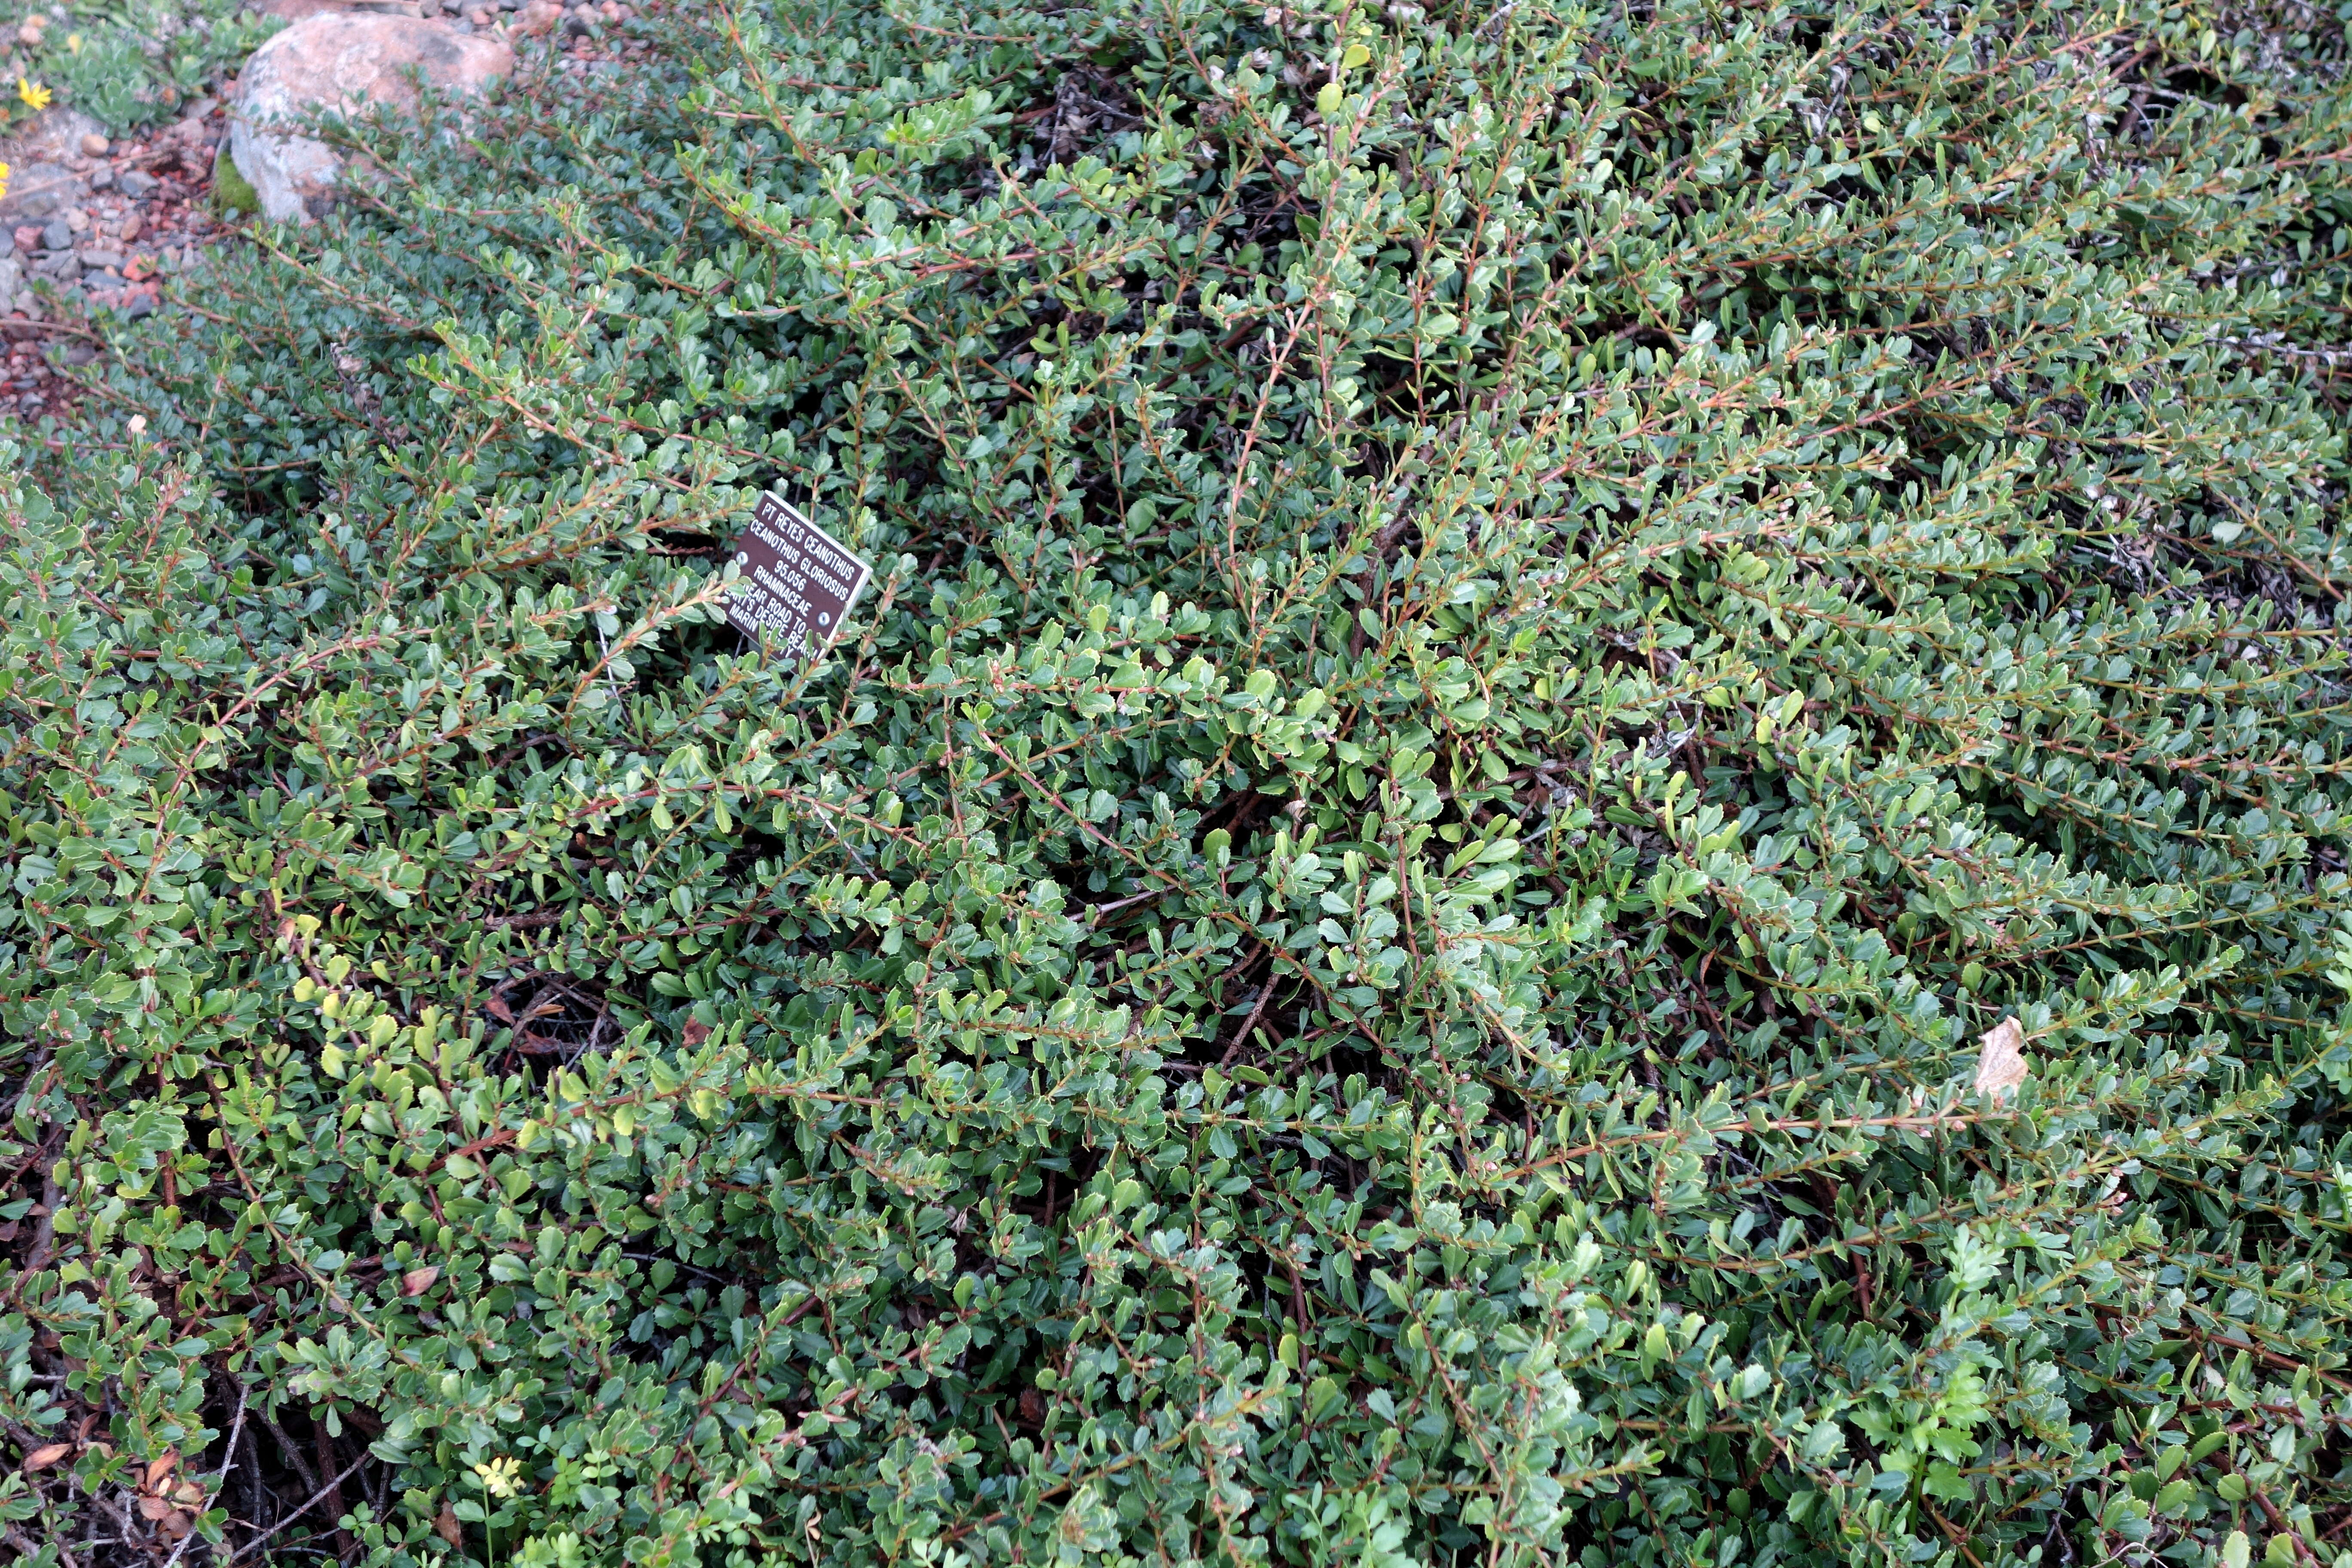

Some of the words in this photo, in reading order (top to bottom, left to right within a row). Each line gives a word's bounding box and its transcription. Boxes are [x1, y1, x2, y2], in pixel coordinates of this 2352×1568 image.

[750, 519, 800, 564] CEANOTHUS
[800, 558, 848, 600] GLORIOSUS
[762, 502, 777, 521] PT
[775, 513, 805, 542] REYES
[804, 535, 855, 581] CEANOTHUS
[754, 565, 812, 617] RHAMNACEAE
[774, 560, 807, 591] 95.056
[729, 603, 759, 632] MARIN
[767, 597, 792, 623] ROAD
[793, 616, 807, 635] TO
